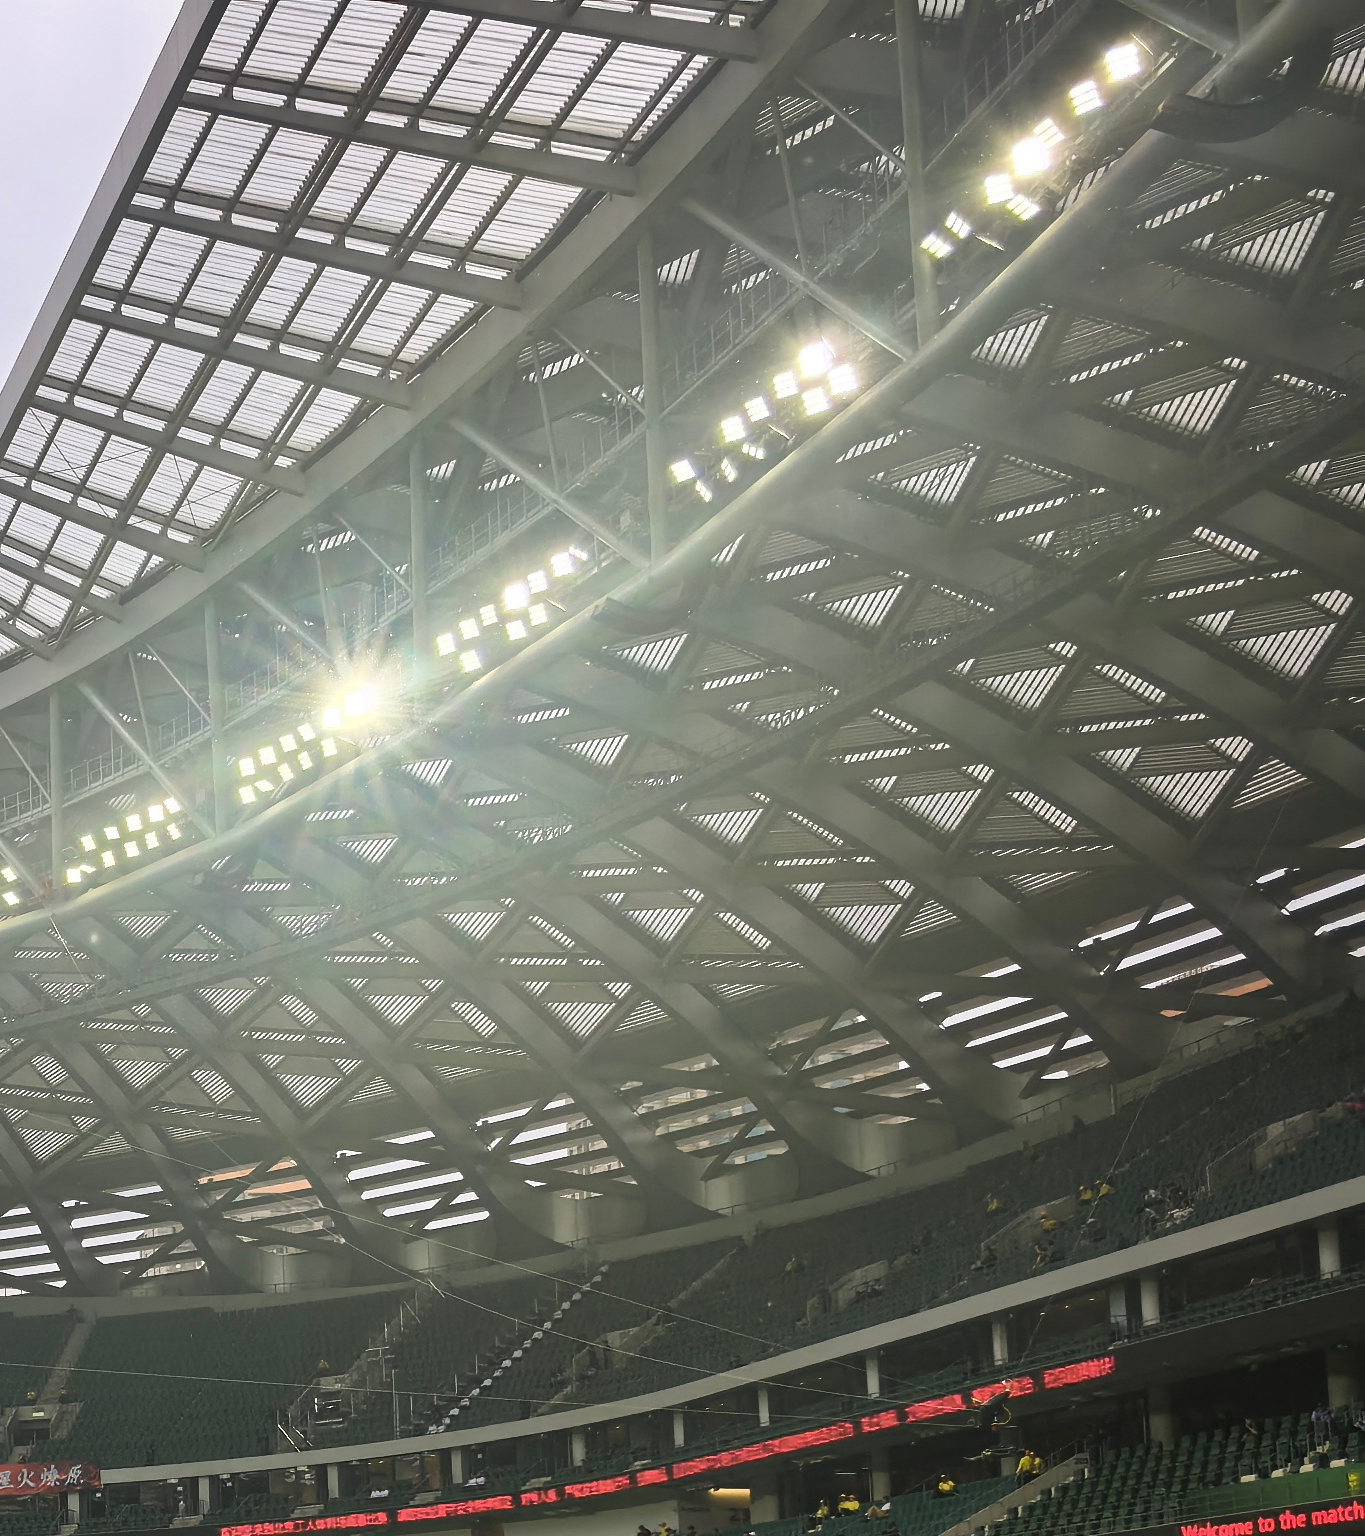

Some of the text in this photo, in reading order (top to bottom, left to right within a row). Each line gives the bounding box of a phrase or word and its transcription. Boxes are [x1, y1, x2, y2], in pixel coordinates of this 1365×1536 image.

[1258, 1517, 1275, 1533] to
[1279, 1509, 1306, 1531] the
[1312, 1500, 1365, 1526] match
